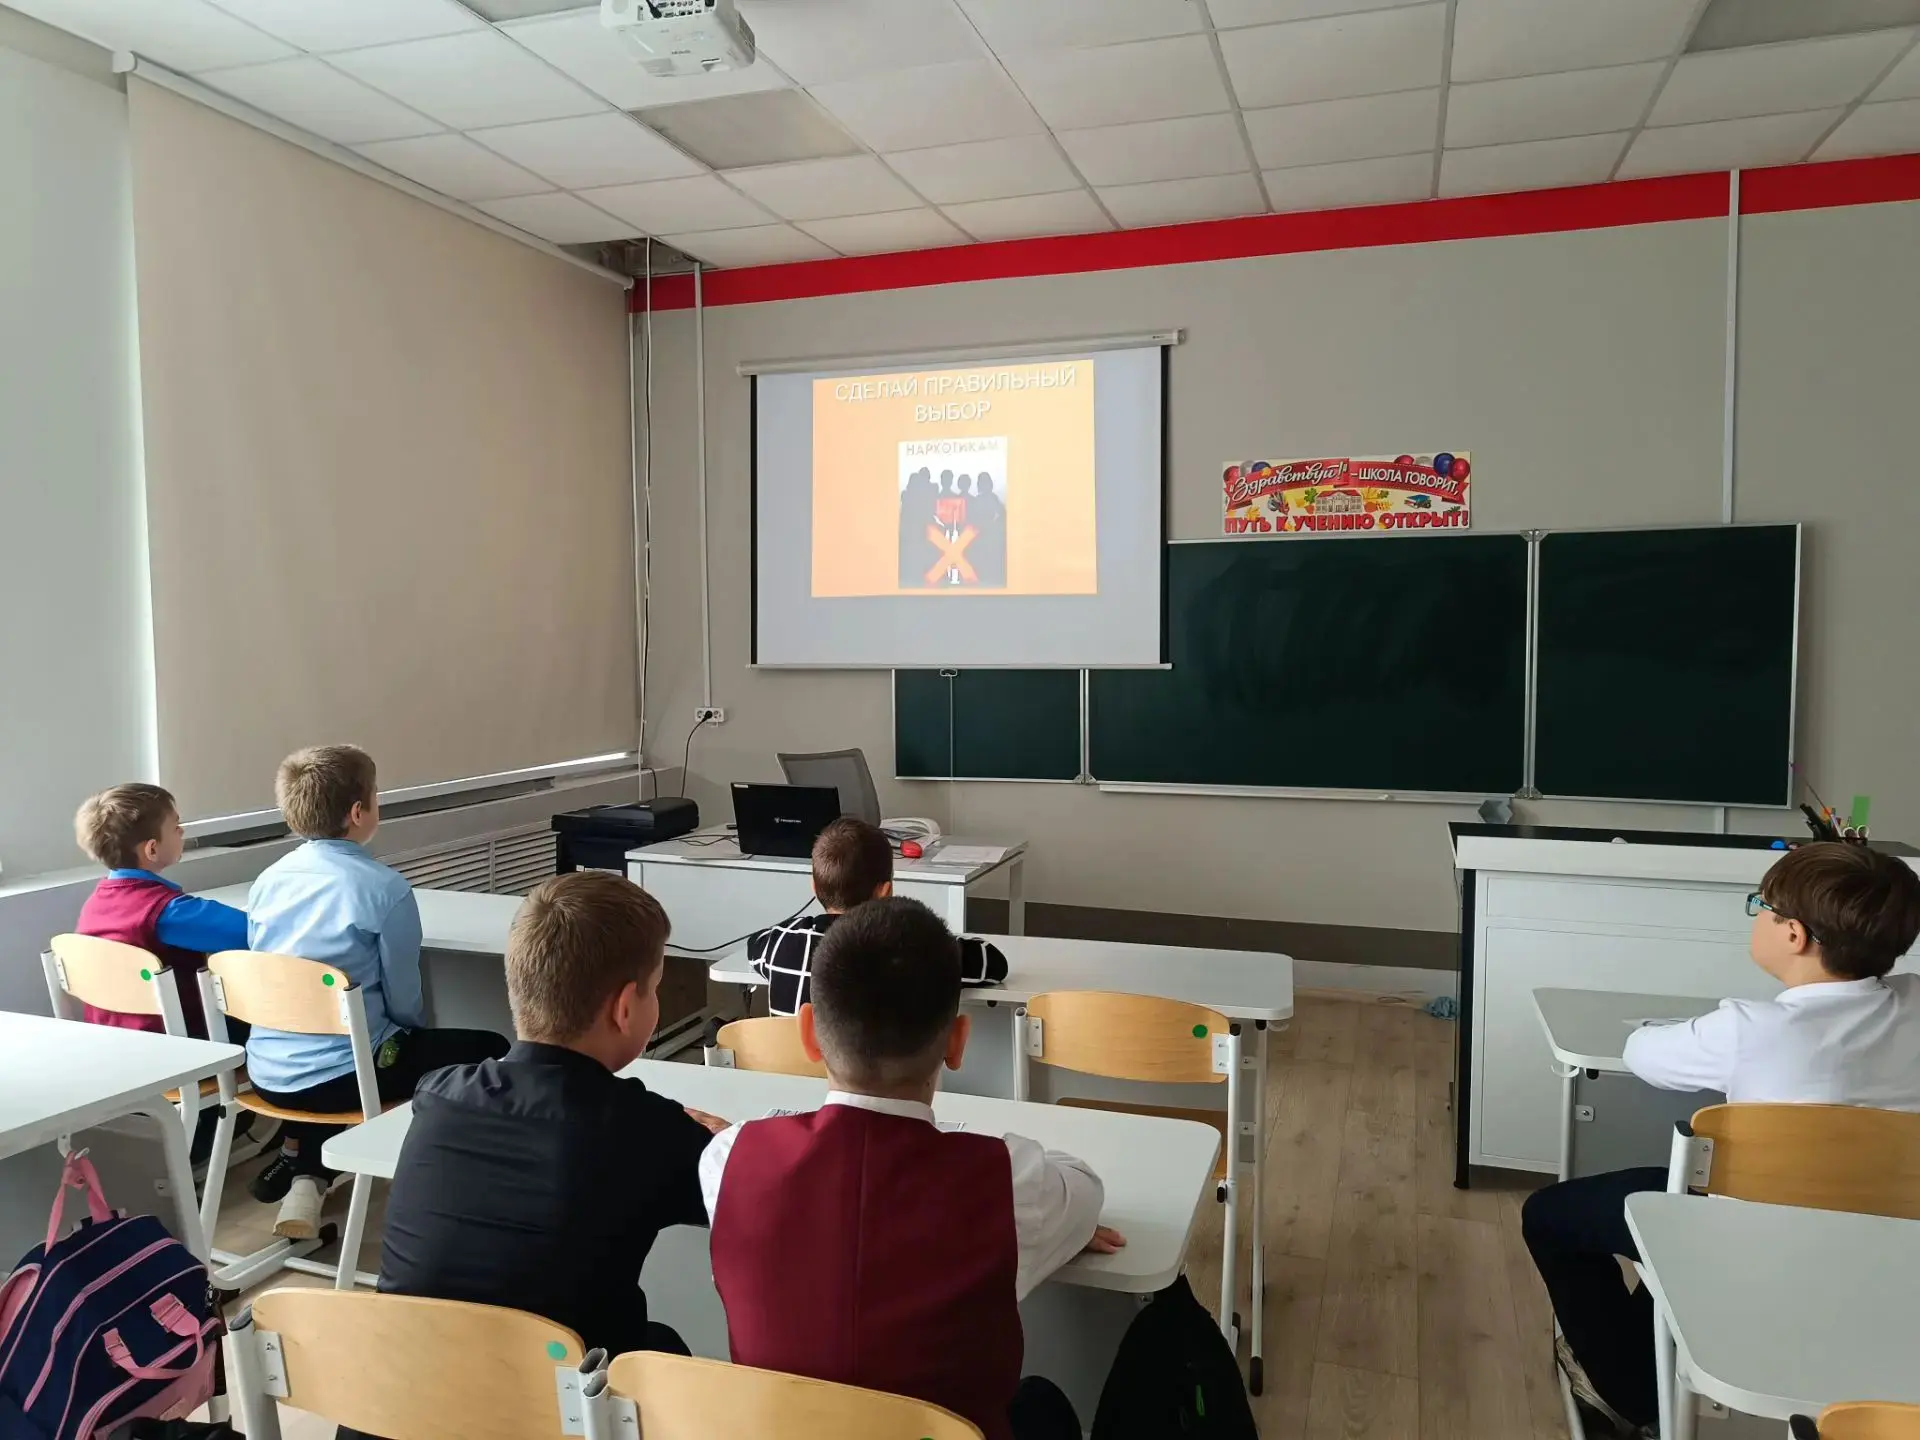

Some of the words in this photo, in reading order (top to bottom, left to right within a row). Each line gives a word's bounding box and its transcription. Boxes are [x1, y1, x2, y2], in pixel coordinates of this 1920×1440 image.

[836, 377, 918, 401] СДЕЛАЙ
[925, 365, 1076, 395] ПРАВИЛЬНЫЙ
[915, 401, 992, 423] ВЫБОР
[906, 440, 999, 456] НАРКОТИКАМ
[1405, 471, 1460, 496] ГОВОРИТ,
[1224, 516, 1272, 534] ПУТЬ
[1276, 515, 1291, 532] К
[1292, 513, 1375, 531] УЧЕНИЮ
[1379, 510, 1469, 530] ОТКРЫТ!
